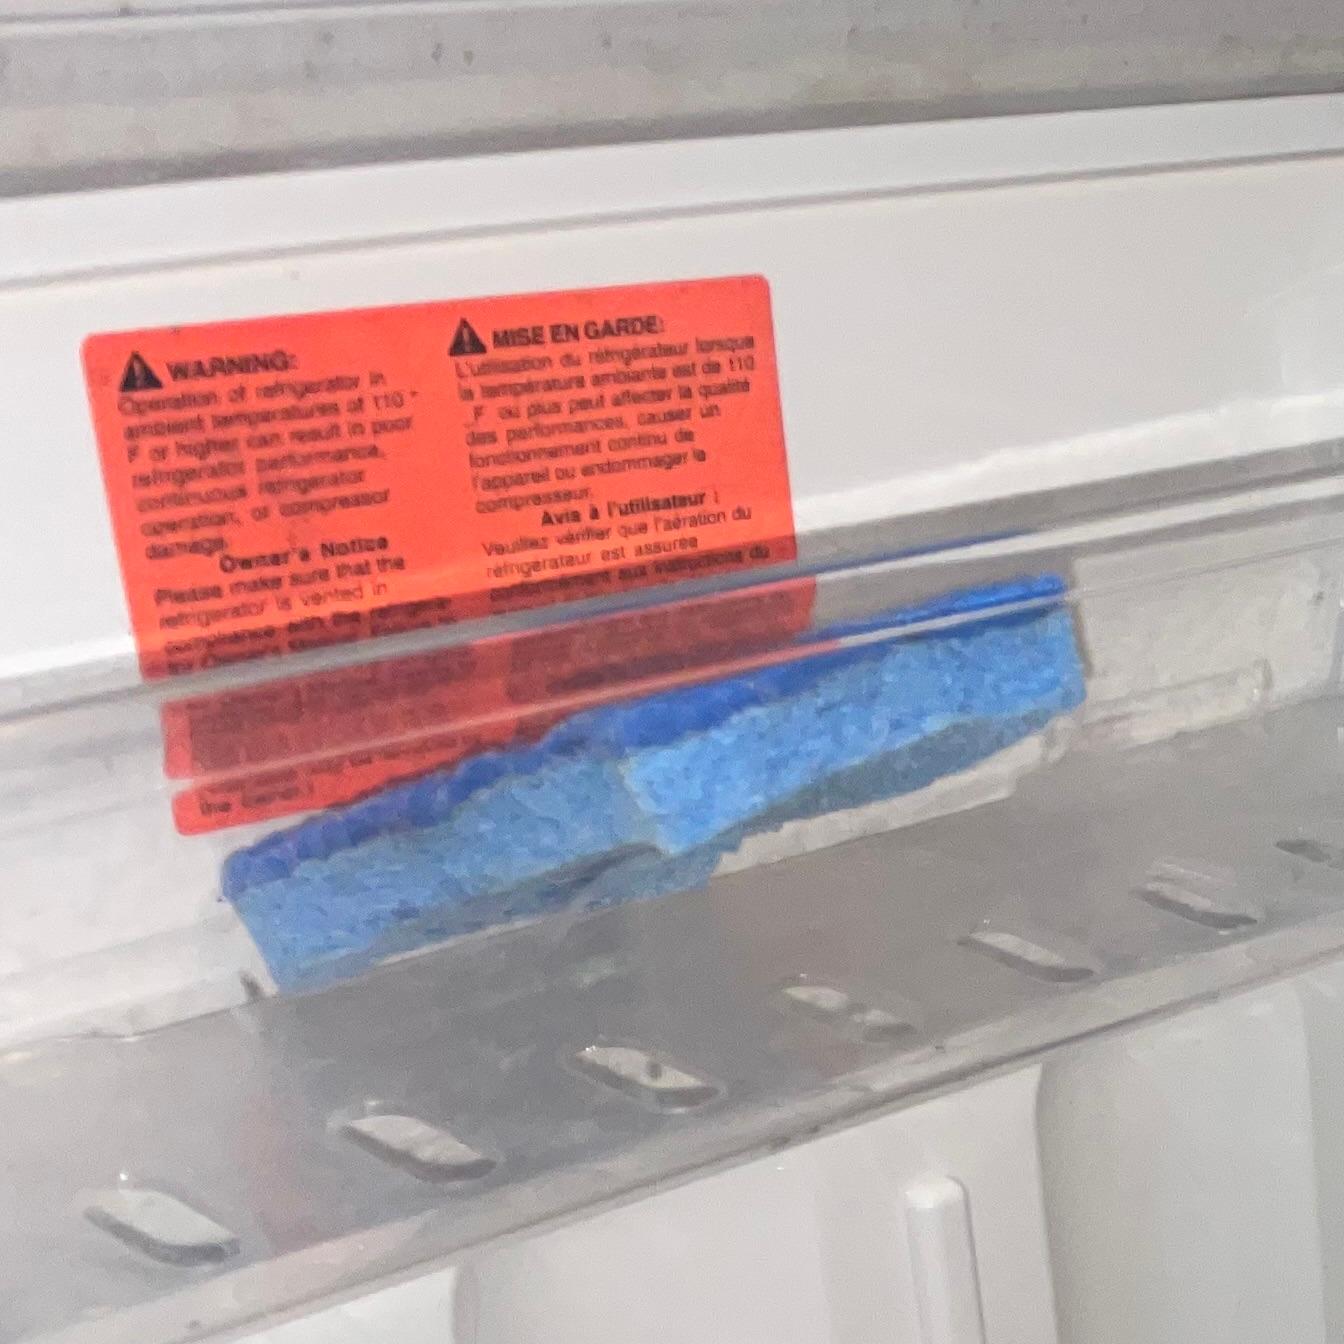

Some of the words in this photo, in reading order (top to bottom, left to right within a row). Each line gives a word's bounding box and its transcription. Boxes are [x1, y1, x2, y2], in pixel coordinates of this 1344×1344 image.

[492, 325, 545, 350] MISE
[550, 323, 580, 344] EN
[583, 315, 664, 340] GARDE:
[166, 349, 297, 381] WARNING:
[455, 354, 553, 379] L'utilisation
[560, 352, 581, 367] du
[696, 335, 754, 354] lorsque
[118, 391, 217, 416] Operation
[228, 384, 246, 402] of
[256, 376, 360, 400] refrigerator
[369, 371, 386, 386] in
[480, 375, 585, 399] température
[590, 365, 667, 388] ambiante
[672, 360, 696, 376] est
[702, 358, 720, 374] de
[527, 401, 562, 419] plus
[568, 394, 604, 415] peut
[611, 388, 673, 407] affecter
[678, 383, 692, 399] la
[699, 377, 750, 400] qualité
[212, 402, 340, 429] temperatures
[466, 430, 498, 447] des
[637, 406, 692, 427] causer
[700, 403, 721, 419] un
[175, 438, 239, 461] higher
[247, 433, 281, 449] can
[289, 423, 340, 443] result
[348, 422, 365, 436] in
[371, 416, 413, 435] poor
[469, 440, 602, 469] fonctionnement
[607, 430, 667, 452] continu
[674, 428, 694, 444] de
[132, 460, 245, 489] refrigerator
[554, 467, 576, 481] ou
[581, 452, 689, 478] endommager
[136, 484, 247, 512] continuous
[258, 469, 364, 495] refrigerator
[251, 505, 269, 521] or
[279, 489, 390, 517] compressor
[541, 508, 581, 528] Avis
[588, 503, 600, 520] à
[606, 490, 706, 518] l'utilisateur
[481, 535, 549, 558] Veuillez
[556, 525, 613, 548] vérifier
[617, 520, 648, 538] que
[654, 508, 727, 535] l'aération
[733, 505, 753, 521] du
[220, 548, 311, 574] Owner's
[320, 536, 389, 558] Notice
[600, 544, 626, 562] est
[155, 586, 223, 605] Please
[230, 577, 282, 594] make
[290, 568, 329, 586] sure
[336, 561, 371, 578] that
[377, 557, 405, 572] the
[160, 600, 265, 629] refrigerator
[276, 596, 292, 610] is
[301, 586, 364, 607] vented
[373, 582, 388, 596] in
